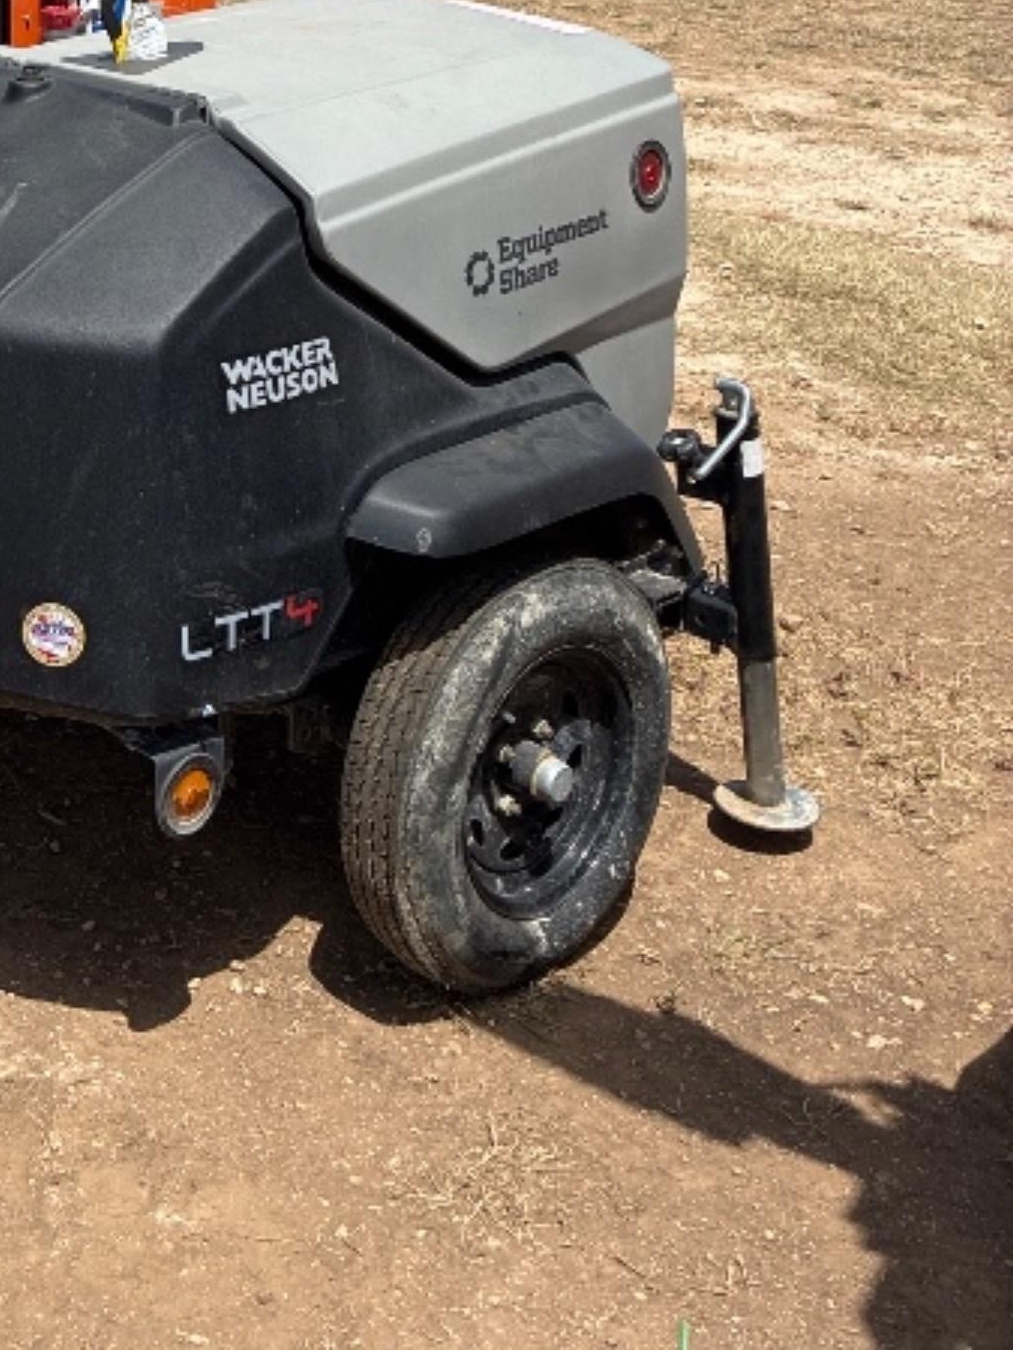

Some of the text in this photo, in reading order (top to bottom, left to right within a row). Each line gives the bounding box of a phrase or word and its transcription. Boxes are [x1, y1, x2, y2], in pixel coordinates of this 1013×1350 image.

[497, 209, 609, 264] Equipment
[499, 257, 559, 295] Share
[220, 336, 333, 385] WACKER
[226, 360, 339, 415] NEUSON
